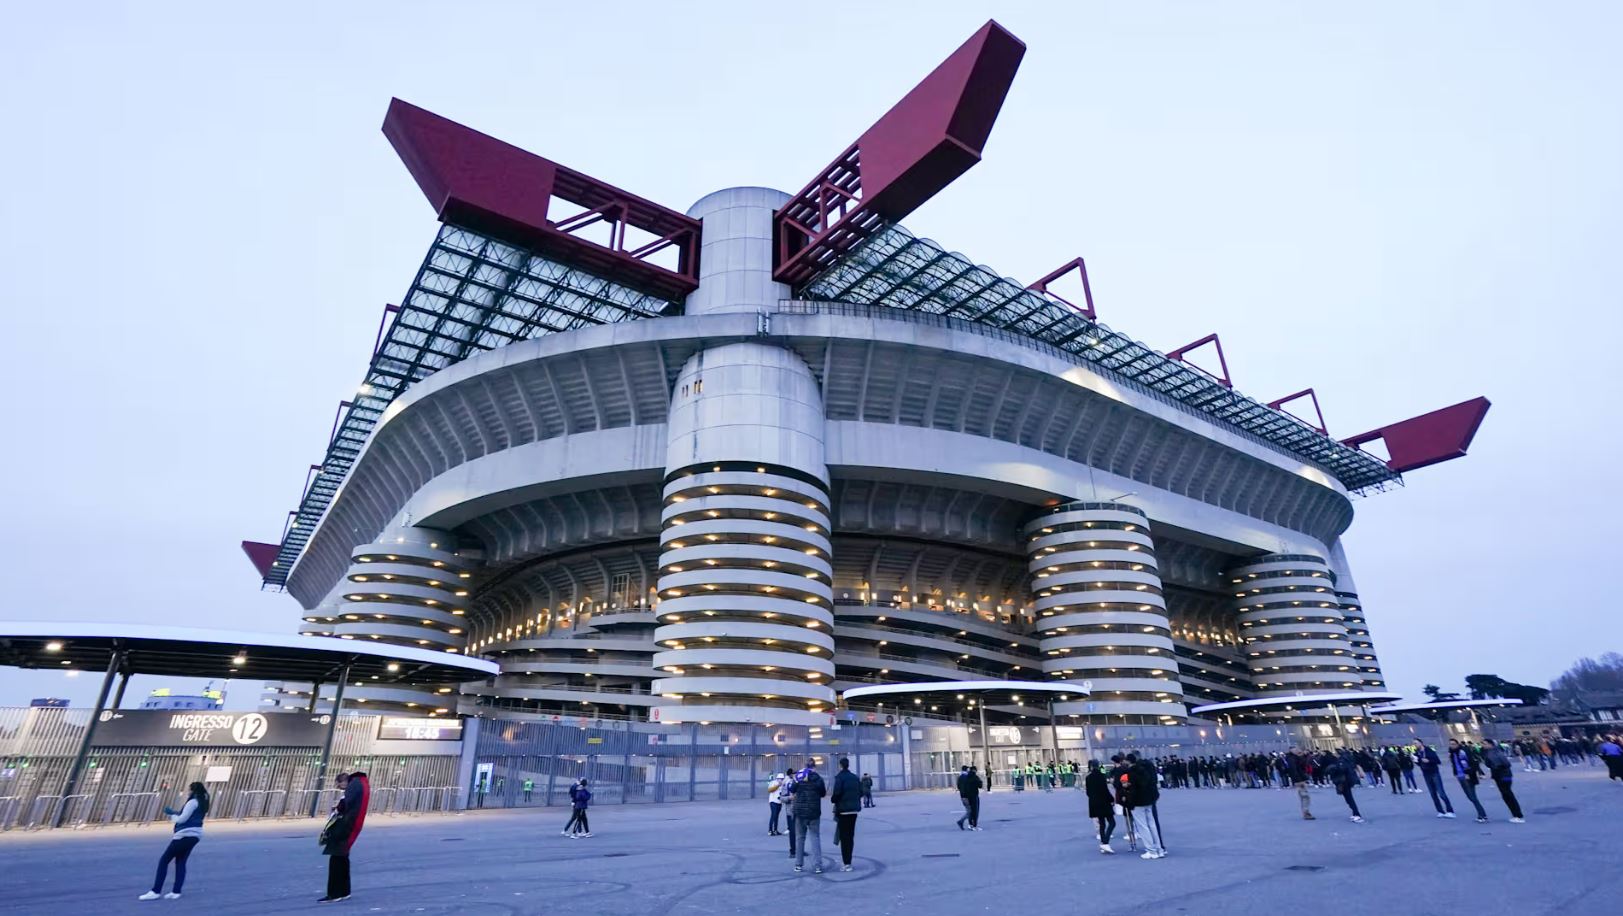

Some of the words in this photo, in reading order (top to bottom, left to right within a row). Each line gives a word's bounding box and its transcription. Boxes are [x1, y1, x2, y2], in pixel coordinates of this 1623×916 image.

[169, 714, 234, 729] INGRESSO
[239, 716, 262, 740] 12
[182, 728, 214, 742] GATE
